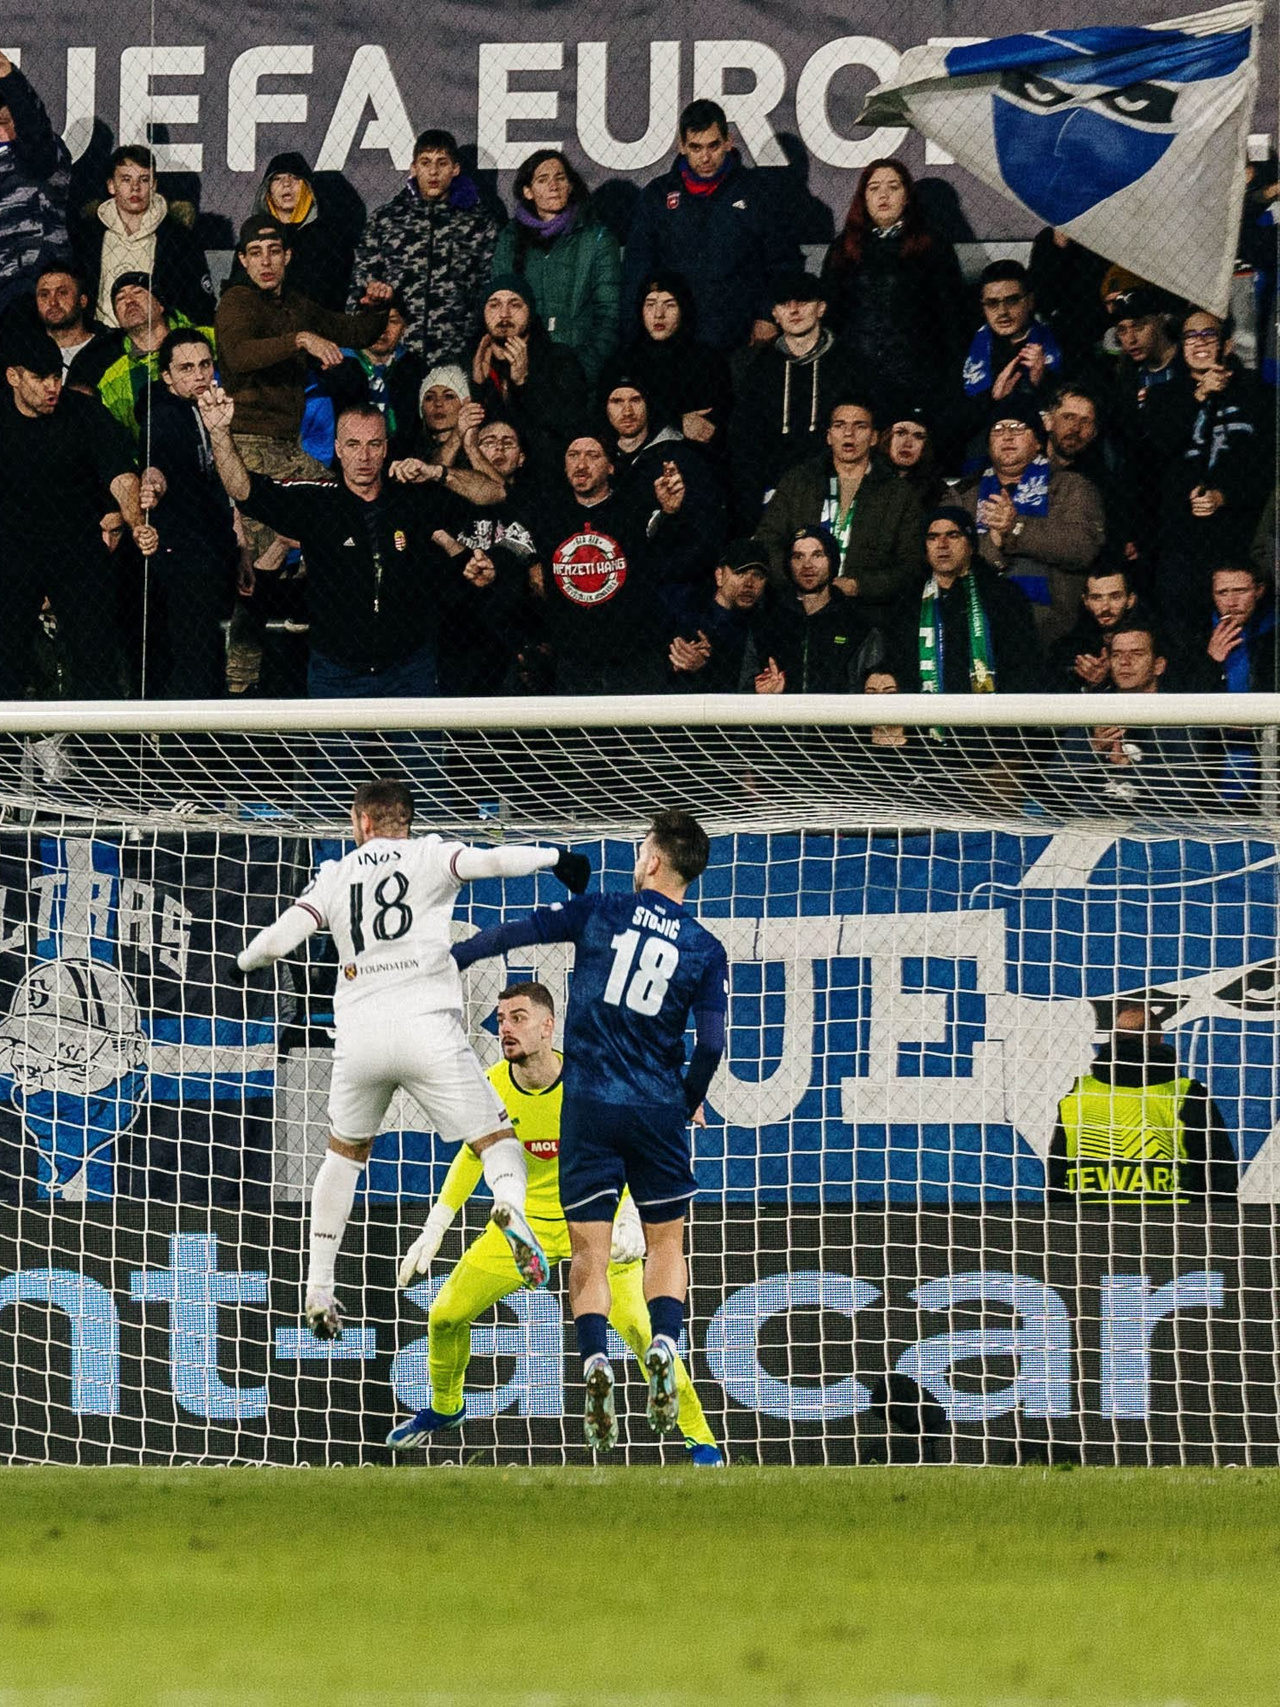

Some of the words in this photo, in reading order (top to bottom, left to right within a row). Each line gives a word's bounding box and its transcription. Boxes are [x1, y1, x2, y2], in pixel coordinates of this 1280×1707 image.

[477, 35, 996, 171] EURO
[349, 870, 414, 957] 18
[631, 905, 681, 941] STOJIĆ
[359, 959, 421, 976] FOUNDATION
[603, 927, 680, 1017] 18
[530, 1141, 559, 1153] MOL
[1065, 1165, 1184, 1194] TEWAR
